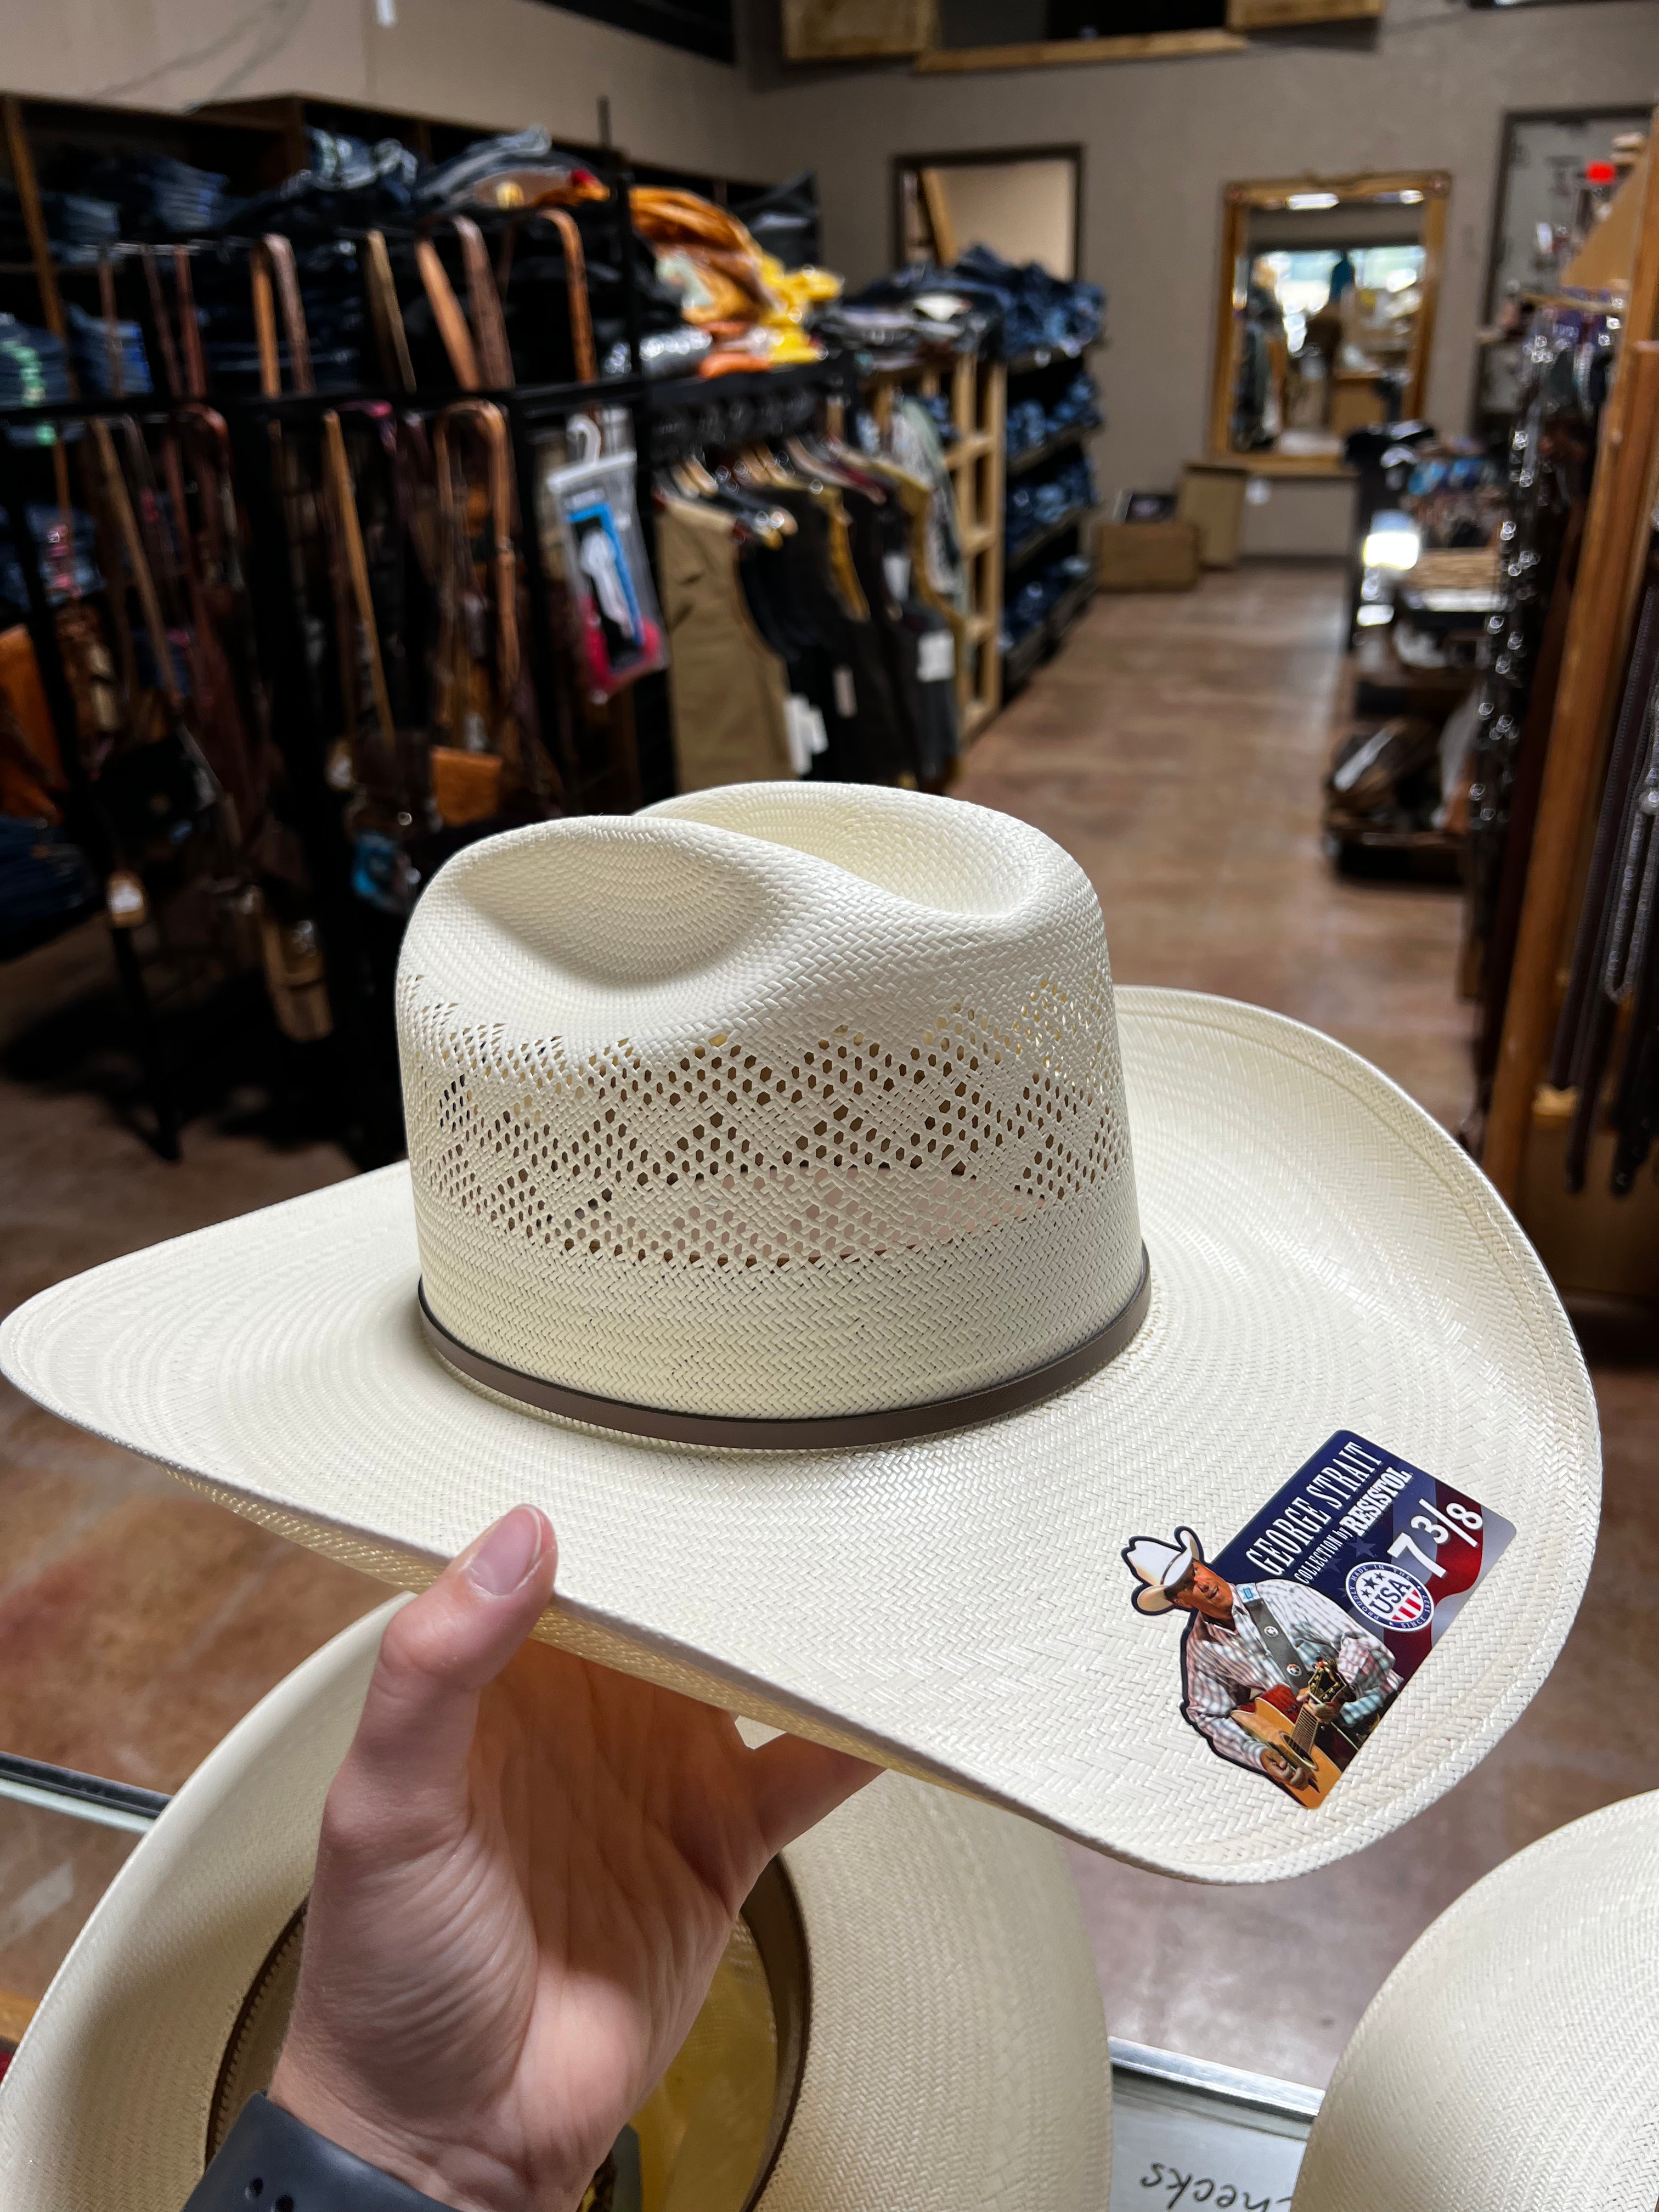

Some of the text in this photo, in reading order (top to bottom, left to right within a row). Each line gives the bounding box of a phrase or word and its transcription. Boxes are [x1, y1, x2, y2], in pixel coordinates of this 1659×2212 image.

[1245, 1441, 1382, 1576] GEORGE STRAIT
[1294, 1466, 1414, 1584] COLLECTION by RESISTOL
[1350, 1566, 1368, 1582] MADE
[1393, 1568, 1412, 1581] THE
[1350, 1585, 1379, 1621] PROUDLY
[1369, 1578, 1412, 1613] USA
[1401, 1616, 1426, 1628] SINCE
